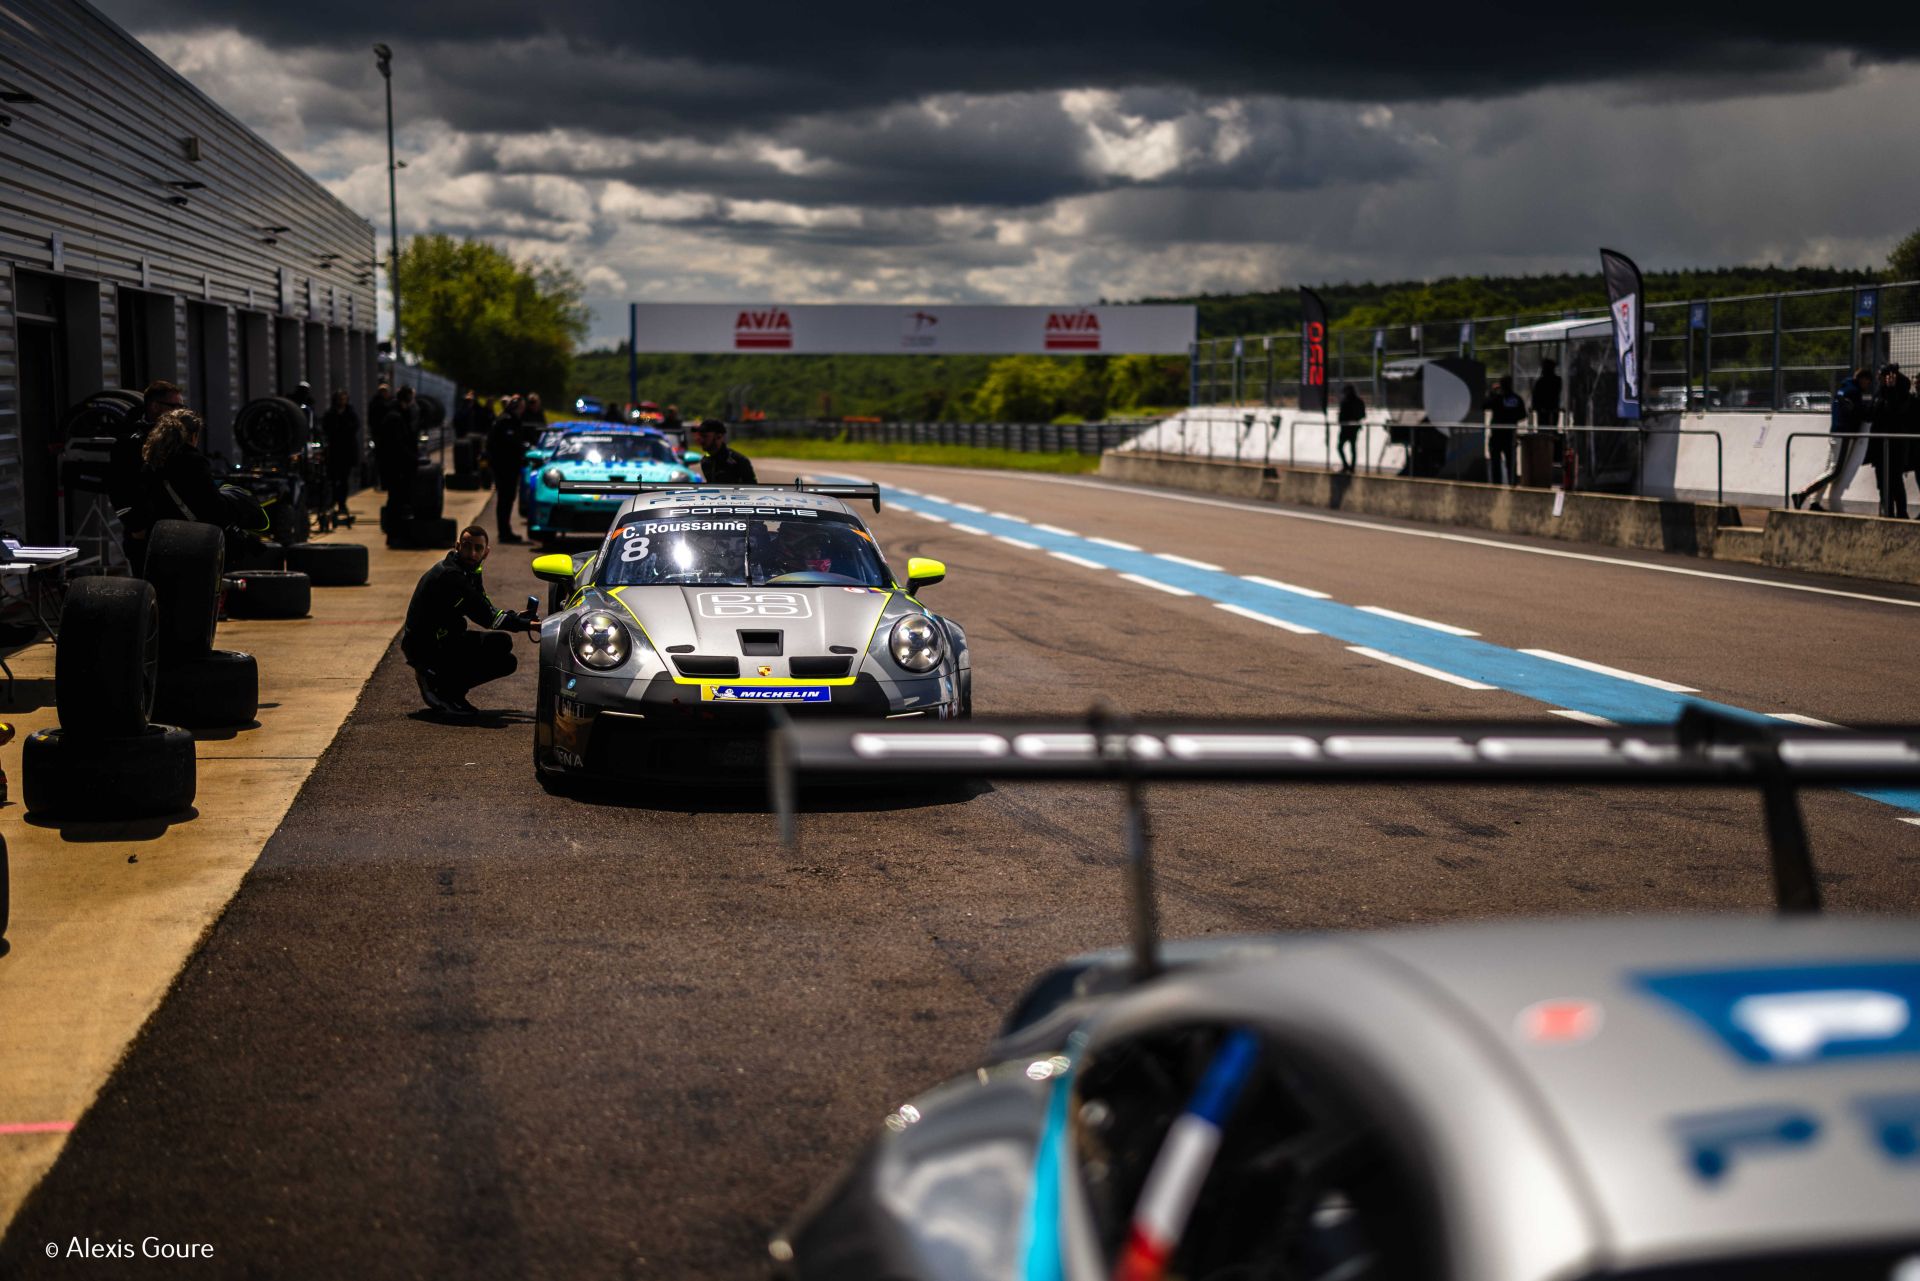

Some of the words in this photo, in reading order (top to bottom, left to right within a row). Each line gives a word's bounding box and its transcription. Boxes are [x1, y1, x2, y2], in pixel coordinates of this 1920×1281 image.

[736, 306, 791, 329] AVIA
[1044, 307, 1101, 330] AVIA
[669, 507, 818, 517] PORSCHE
[622, 526, 640, 540] C.
[645, 521, 747, 536] Roussanne
[621, 537, 650, 562] 8
